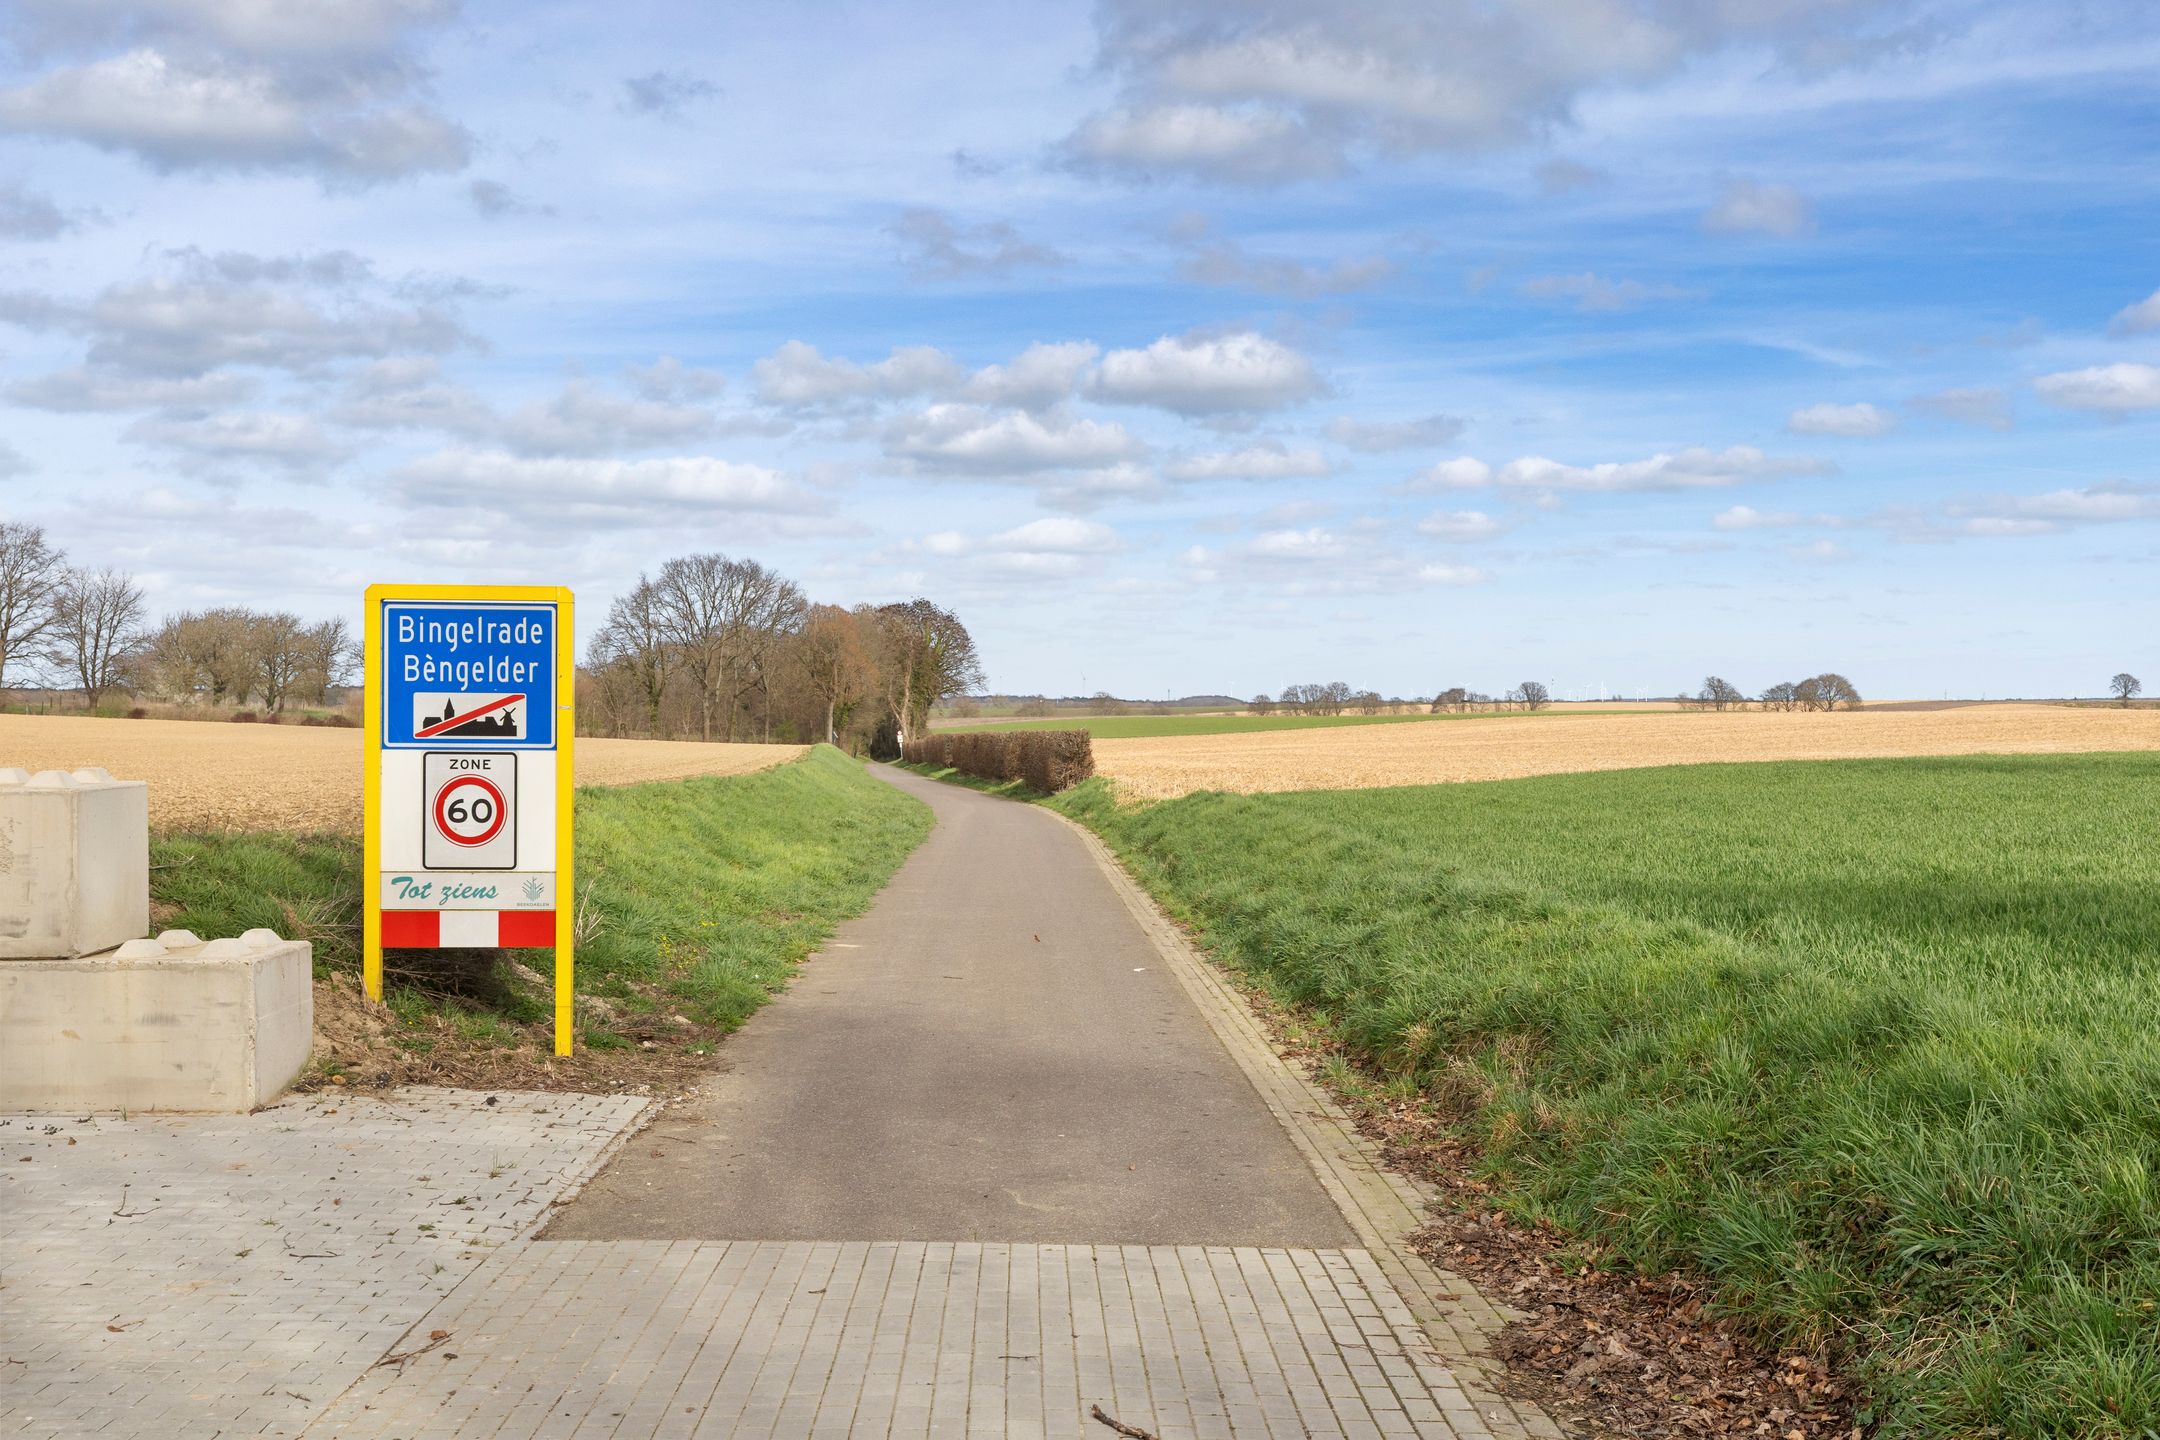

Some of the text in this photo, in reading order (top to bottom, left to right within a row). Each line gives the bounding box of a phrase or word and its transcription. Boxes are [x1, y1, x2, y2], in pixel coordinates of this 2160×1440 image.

[399, 615, 543, 653] Bingelrade
[404, 653, 539, 691] Bèngelder
[449, 759, 492, 770] ZONE
[447, 798, 493, 824] 60
[391, 876, 499, 906] Tot ziens
